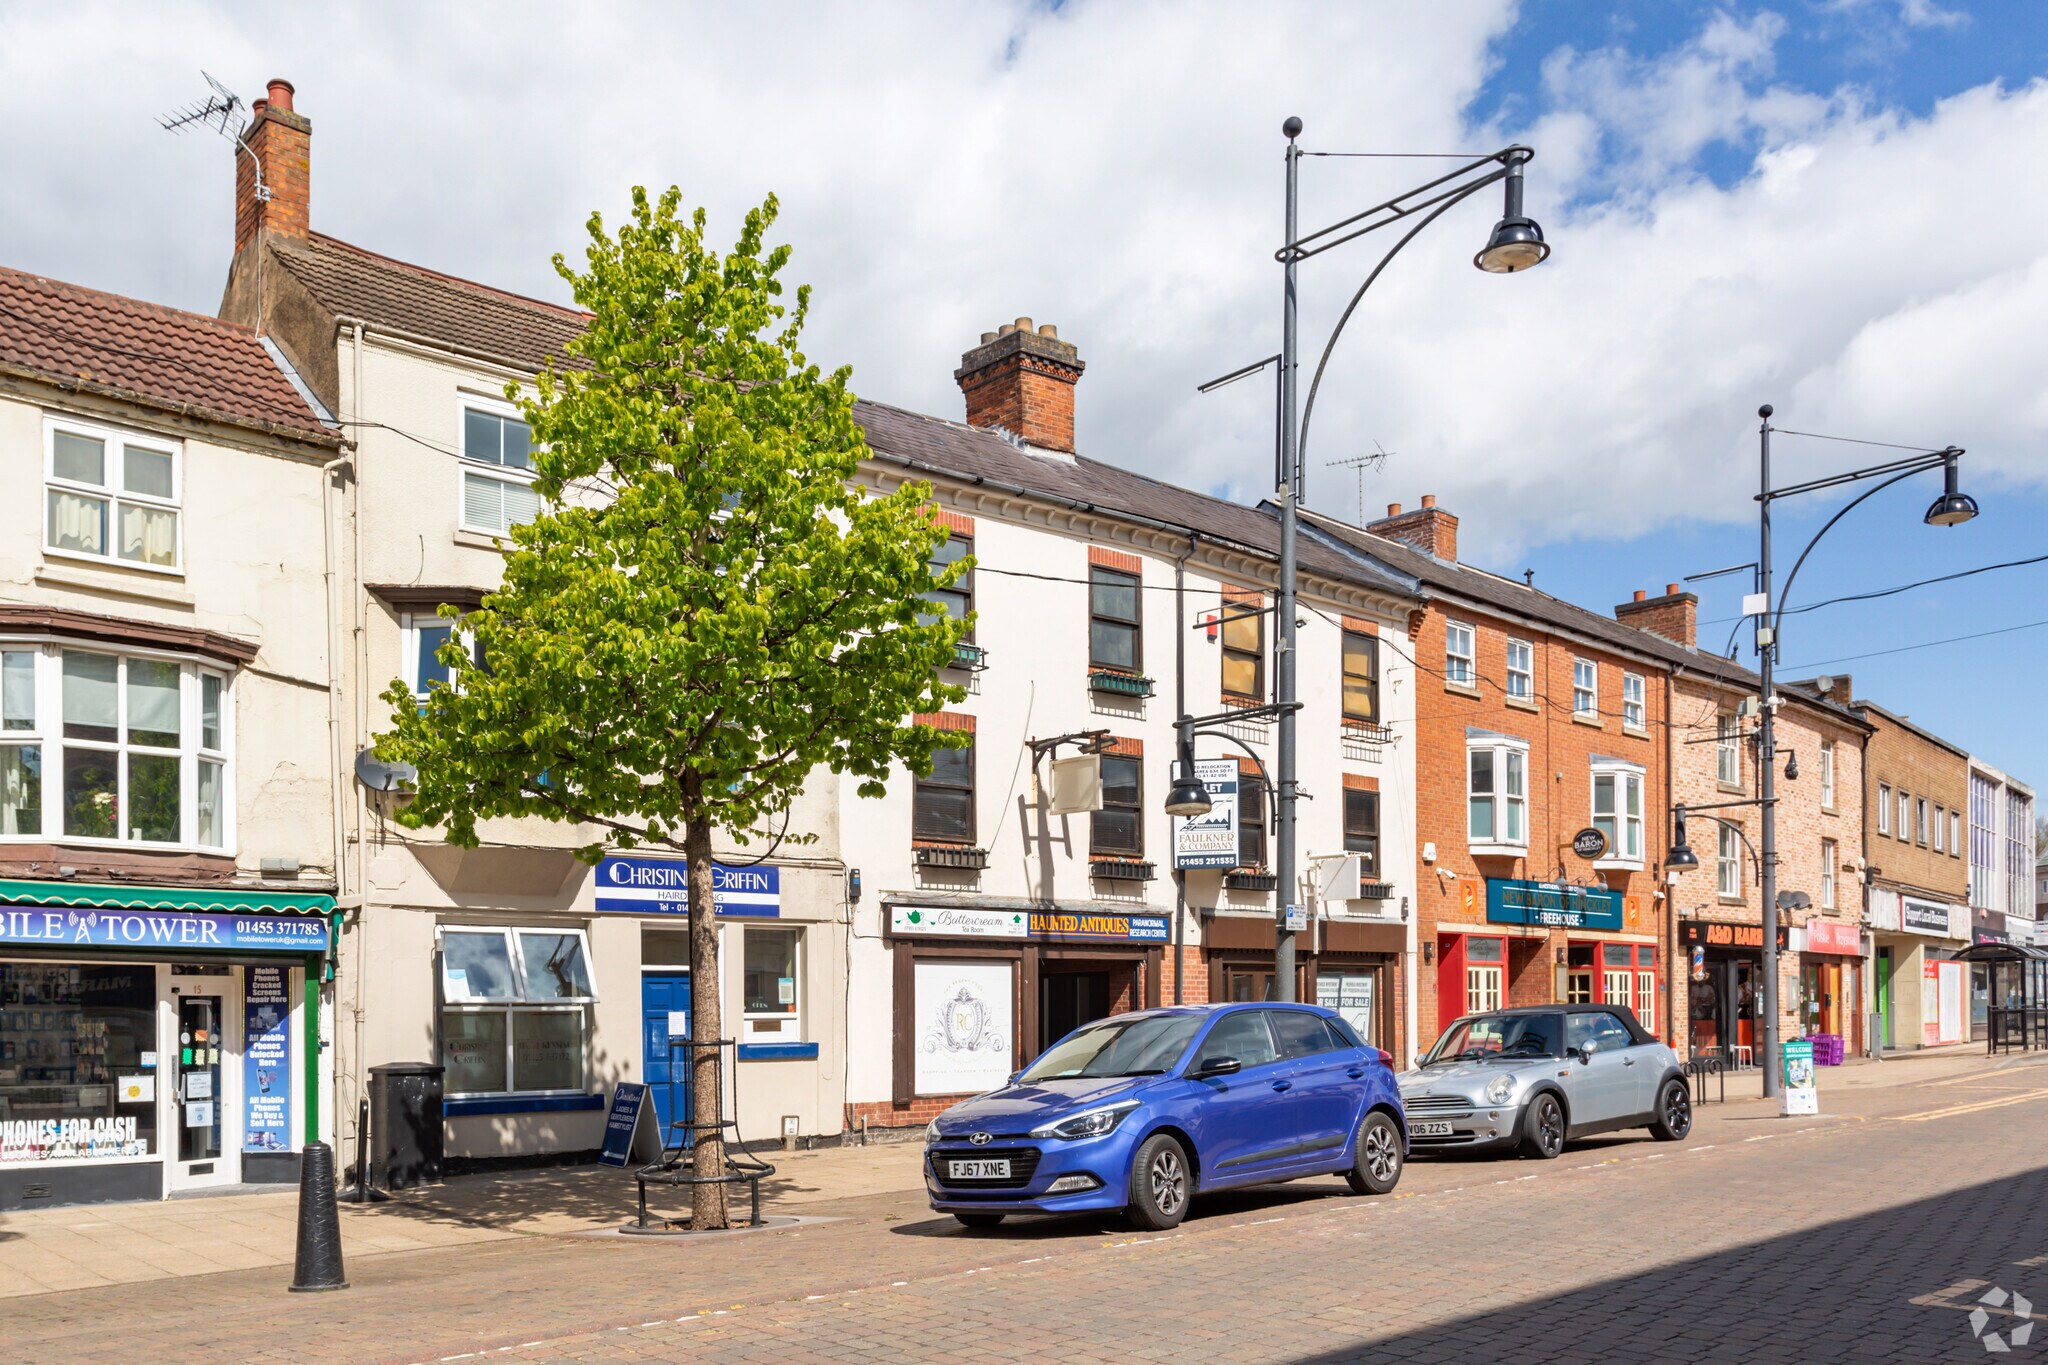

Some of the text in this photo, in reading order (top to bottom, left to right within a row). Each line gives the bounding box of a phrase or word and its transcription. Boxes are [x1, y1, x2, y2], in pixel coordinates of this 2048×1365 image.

[1203, 783, 1222, 793] LET
[1179, 832, 1235, 843] FAULKNER
[1188, 840, 1234, 850] COMPANY
[1574, 839, 1603, 849] BARON
[1205, 856, 1234, 865] 251535
[609, 862, 768, 890] CHRISTIN GRIFFIN
[1502, 890, 1612, 912] NEW BARON OF HINCKLEY
[659, 903, 669, 911] Tel
[938, 910, 1004, 926] Buttercream
[1540, 912, 1580, 926] FREEHOUSE
[236, 920, 319, 936] 01455 371785
[1029, 914, 1078, 932] HAUNTED
[1079, 916, 1130, 934] ANTIQUES
[1132, 919, 1165, 928] PARANORMAL
[101, 915, 221, 944] TOWER
[1130, 928, 1167, 938] RESEARCH CENTRE
[1706, 924, 1733, 944] A&D
[1734, 926, 1763, 946] BARB
[236, 936, 323, 945] mobiletoweruk@gmail.com
[194, 985, 202, 994] 15
[1324, 998, 1338, 1006] SALE
[1341, 998, 1369, 1006] FOR SALE
[956, 1013, 972, 1031] RC
[250, 1050, 284, 1058] Unlocked
[60, 1118, 90, 1144] FOR
[94, 1116, 136, 1142] CASH
[1428, 1123, 1448, 1133] ZZS
[953, 1162, 1005, 1176] FJ67 XNE
